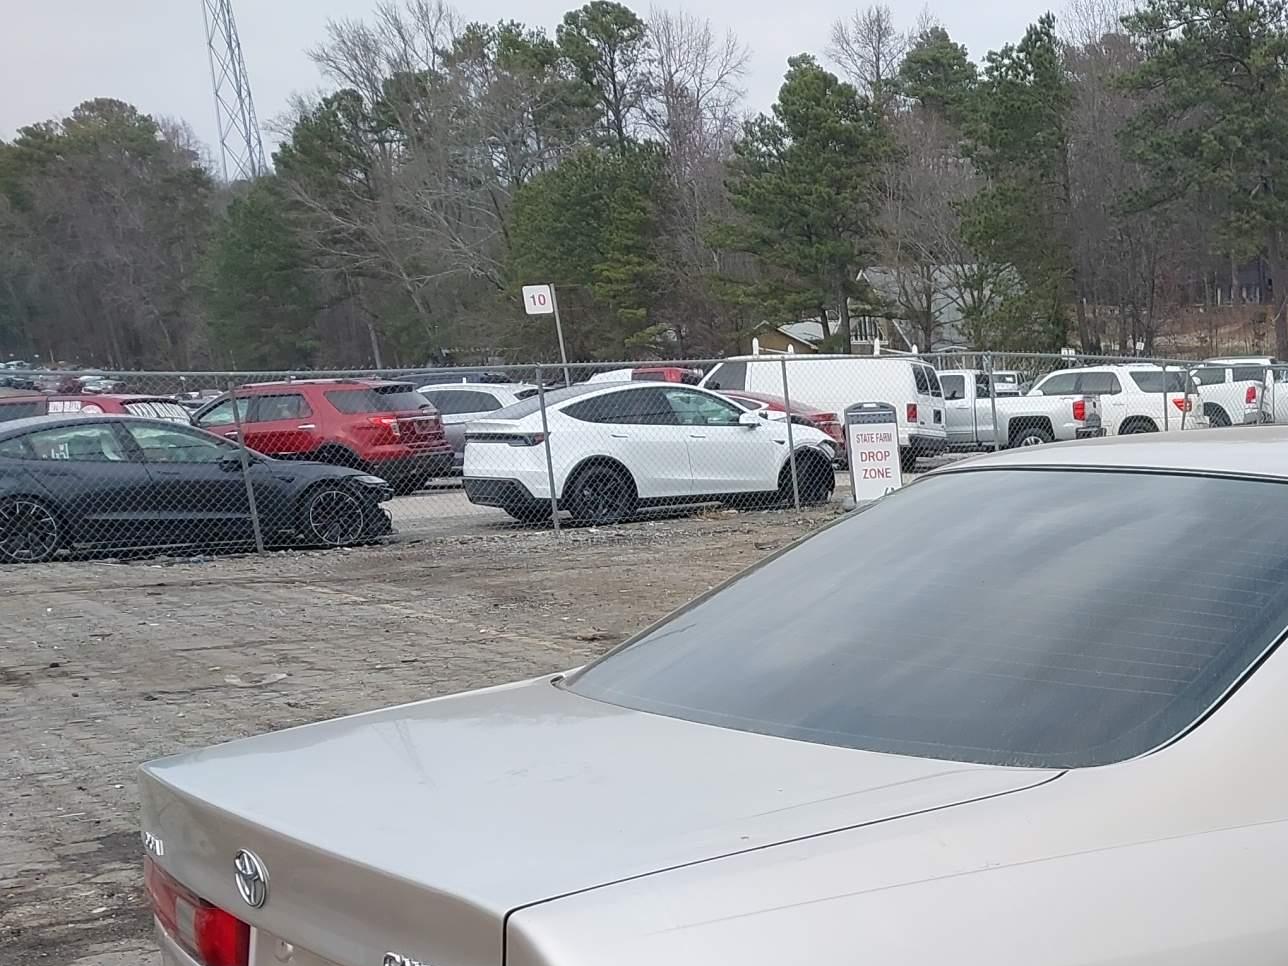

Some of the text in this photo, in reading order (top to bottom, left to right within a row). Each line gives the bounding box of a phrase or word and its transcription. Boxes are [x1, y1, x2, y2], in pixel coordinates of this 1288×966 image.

[529, 294, 546, 306] 10
[856, 432, 892, 444] STATE FARM
[860, 451, 890, 462] DROP
[863, 468, 892, 479] ZONE
